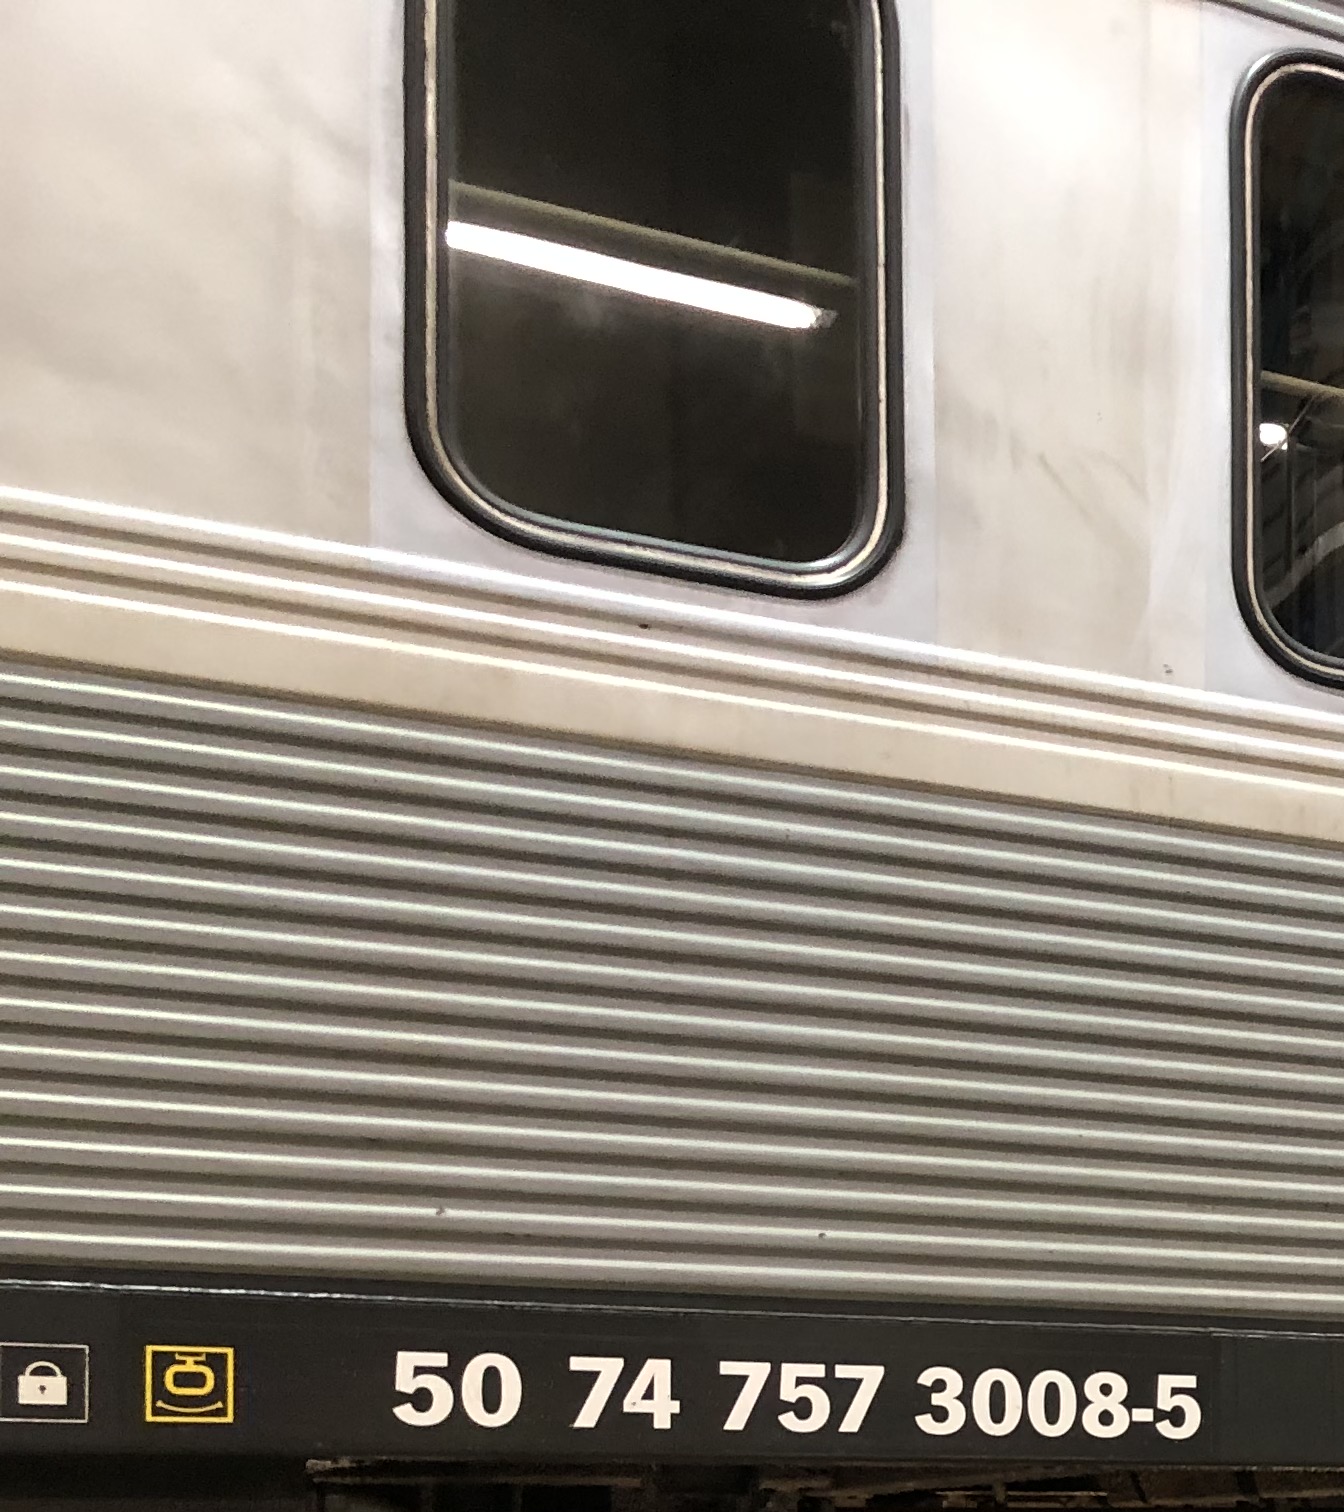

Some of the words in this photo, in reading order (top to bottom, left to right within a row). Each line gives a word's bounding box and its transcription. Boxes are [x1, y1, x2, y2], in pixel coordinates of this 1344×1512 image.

[392, 1350, 523, 1428] 50
[569, 1355, 681, 1430] 74
[719, 1360, 885, 1433] 757
[914, 1366, 1202, 1440] 3008-5
